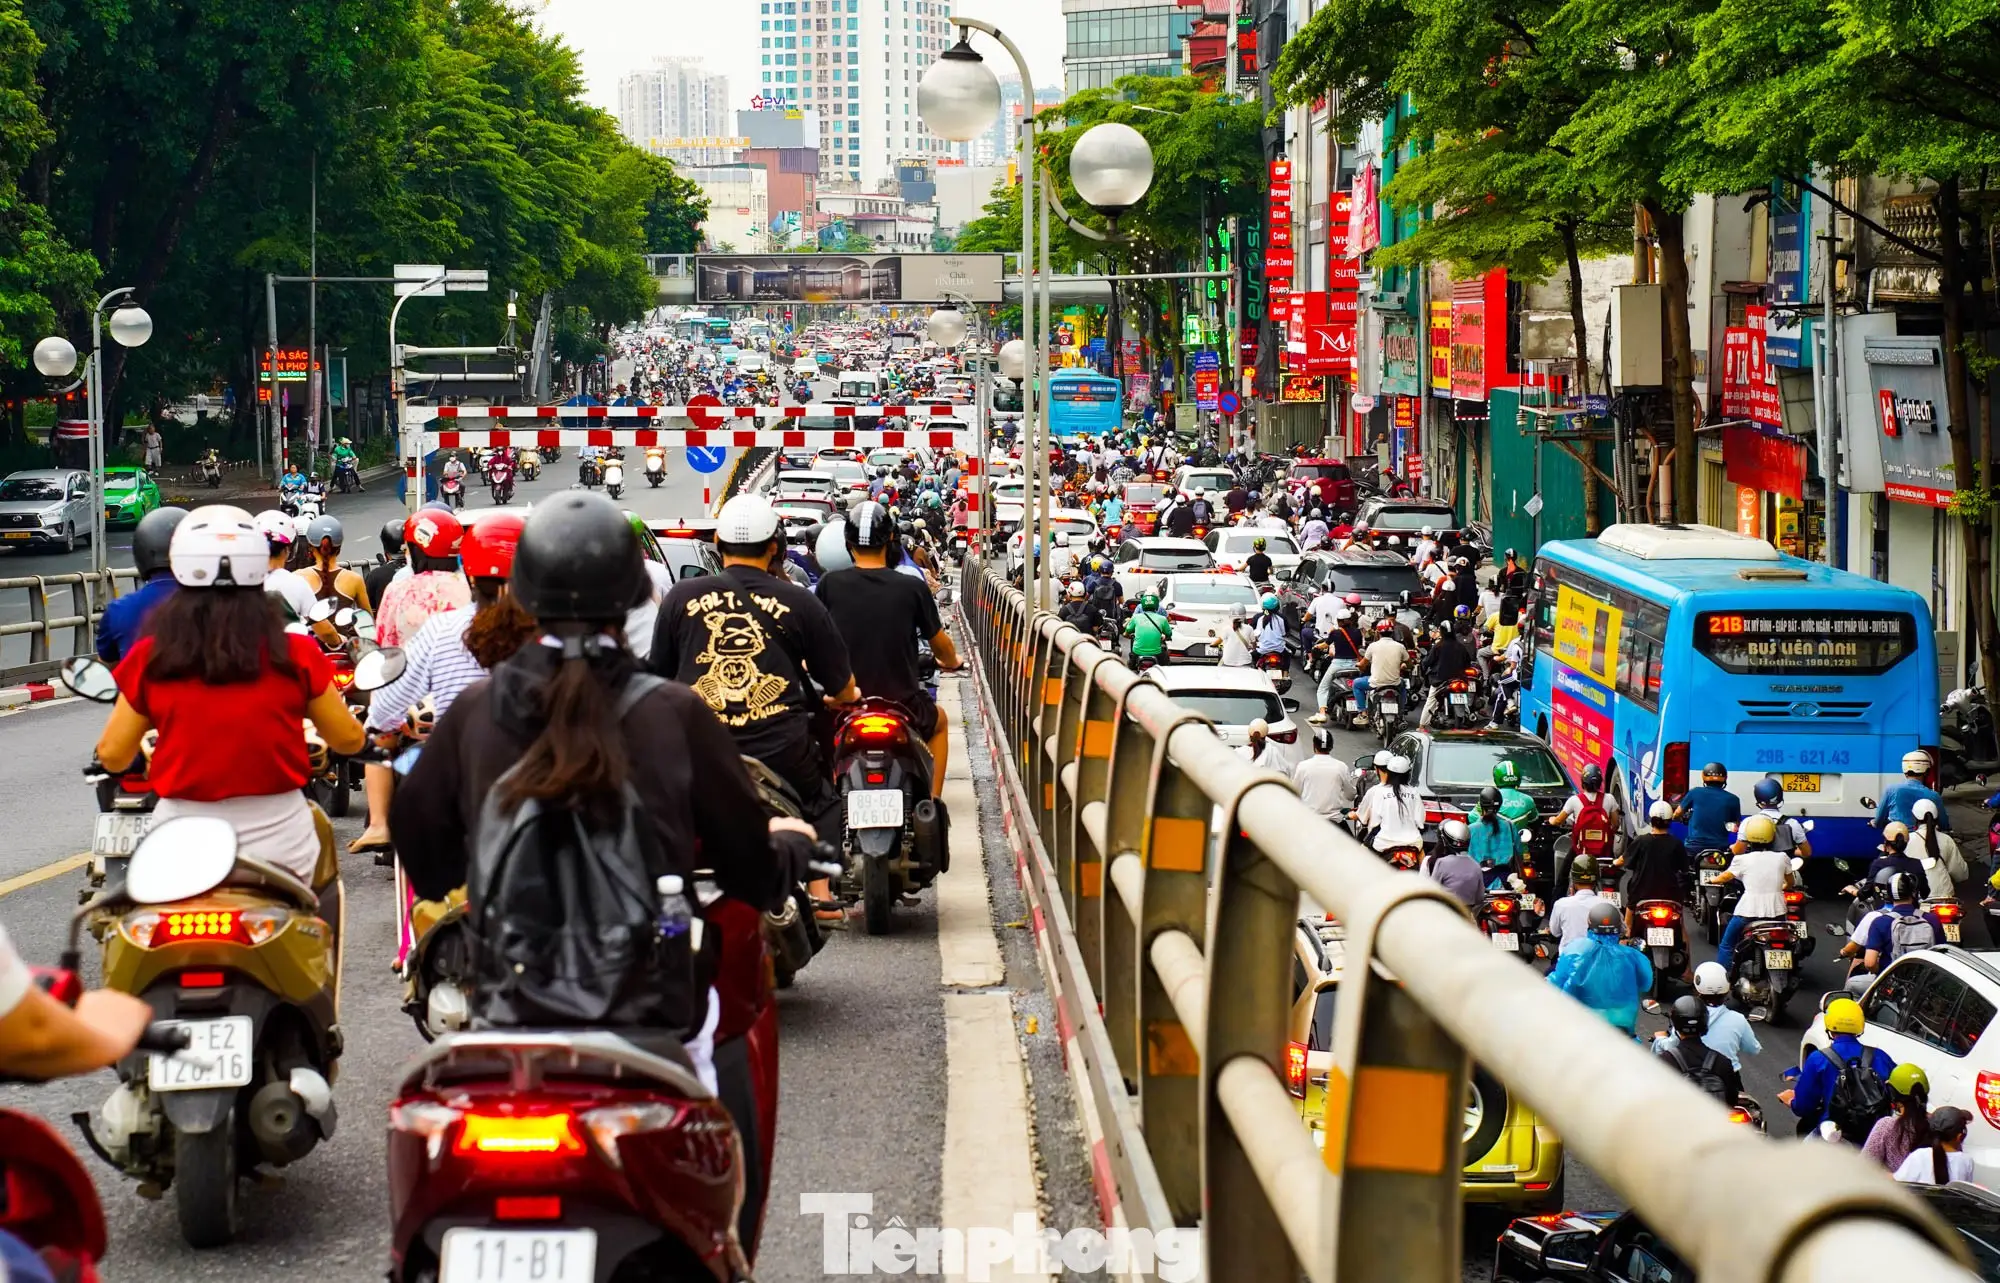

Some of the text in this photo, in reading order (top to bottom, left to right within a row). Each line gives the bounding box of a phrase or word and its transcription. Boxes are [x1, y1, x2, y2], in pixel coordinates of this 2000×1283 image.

[764, 97, 785, 105] PVI
[1273, 231, 1287, 241] Code
[1333, 236, 1348, 244] WH
[1267, 257, 1293, 266] Care Zone
[1331, 302, 1346, 311] VITAL
[288, 350, 308, 360] SÁC
[286, 361, 320, 370] PHOG
[1895, 398, 1931, 426] Hightech
[1710, 616, 1743, 633] 21B
[1748, 642, 1777, 655] BUS
[1759, 658, 1803, 666] Hotline
[1756, 749, 1850, 766] 29B 621.43
[1794, 775, 1810, 783] 29B
[1787, 783, 1817, 791] 621.43
[1383, 792, 1415, 800] LEVNTS
[1503, 798, 1526, 809] Grab
[474, 1239, 569, 1281] 11-B1
